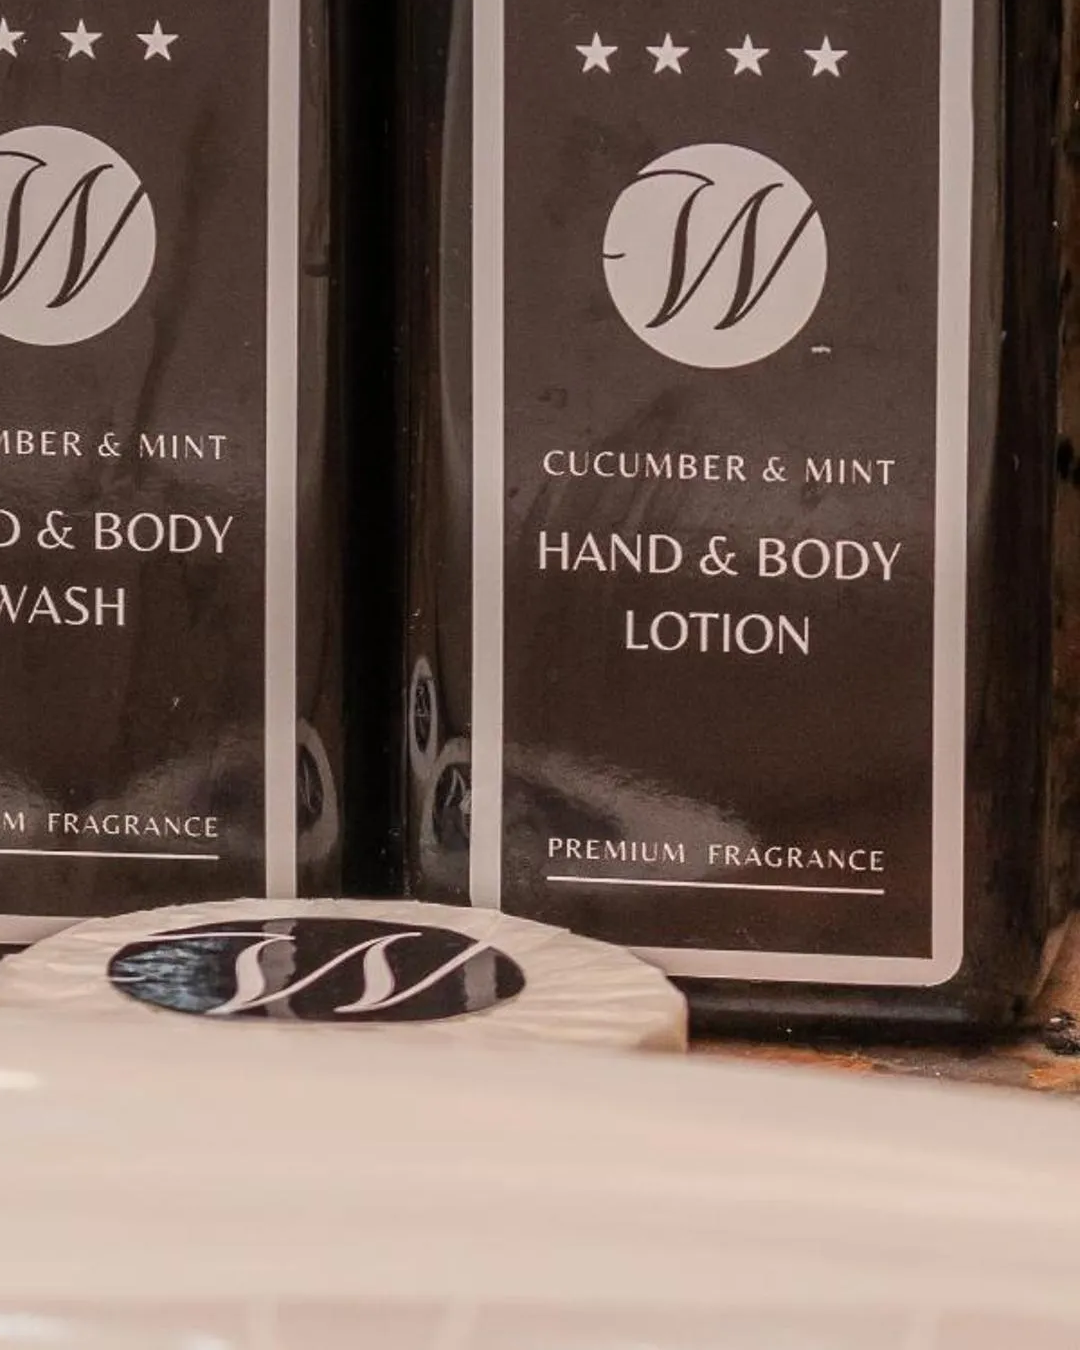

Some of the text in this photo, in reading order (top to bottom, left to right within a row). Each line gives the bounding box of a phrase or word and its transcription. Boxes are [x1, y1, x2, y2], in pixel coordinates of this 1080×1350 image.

[601, 169, 818, 332] W
[98, 432, 121, 457] &
[140, 433, 227, 460] MINT
[543, 449, 896, 486] CUCUMBER & MINT
[37, 509, 75, 550] &
[94, 512, 234, 554] BODY
[539, 530, 901, 581] HAND & BODY
[626, 609, 809, 655] LOTION
[48, 812, 218, 838] FRAGRANCE
[548, 837, 884, 872] PREMIUM FRAGRANCE
